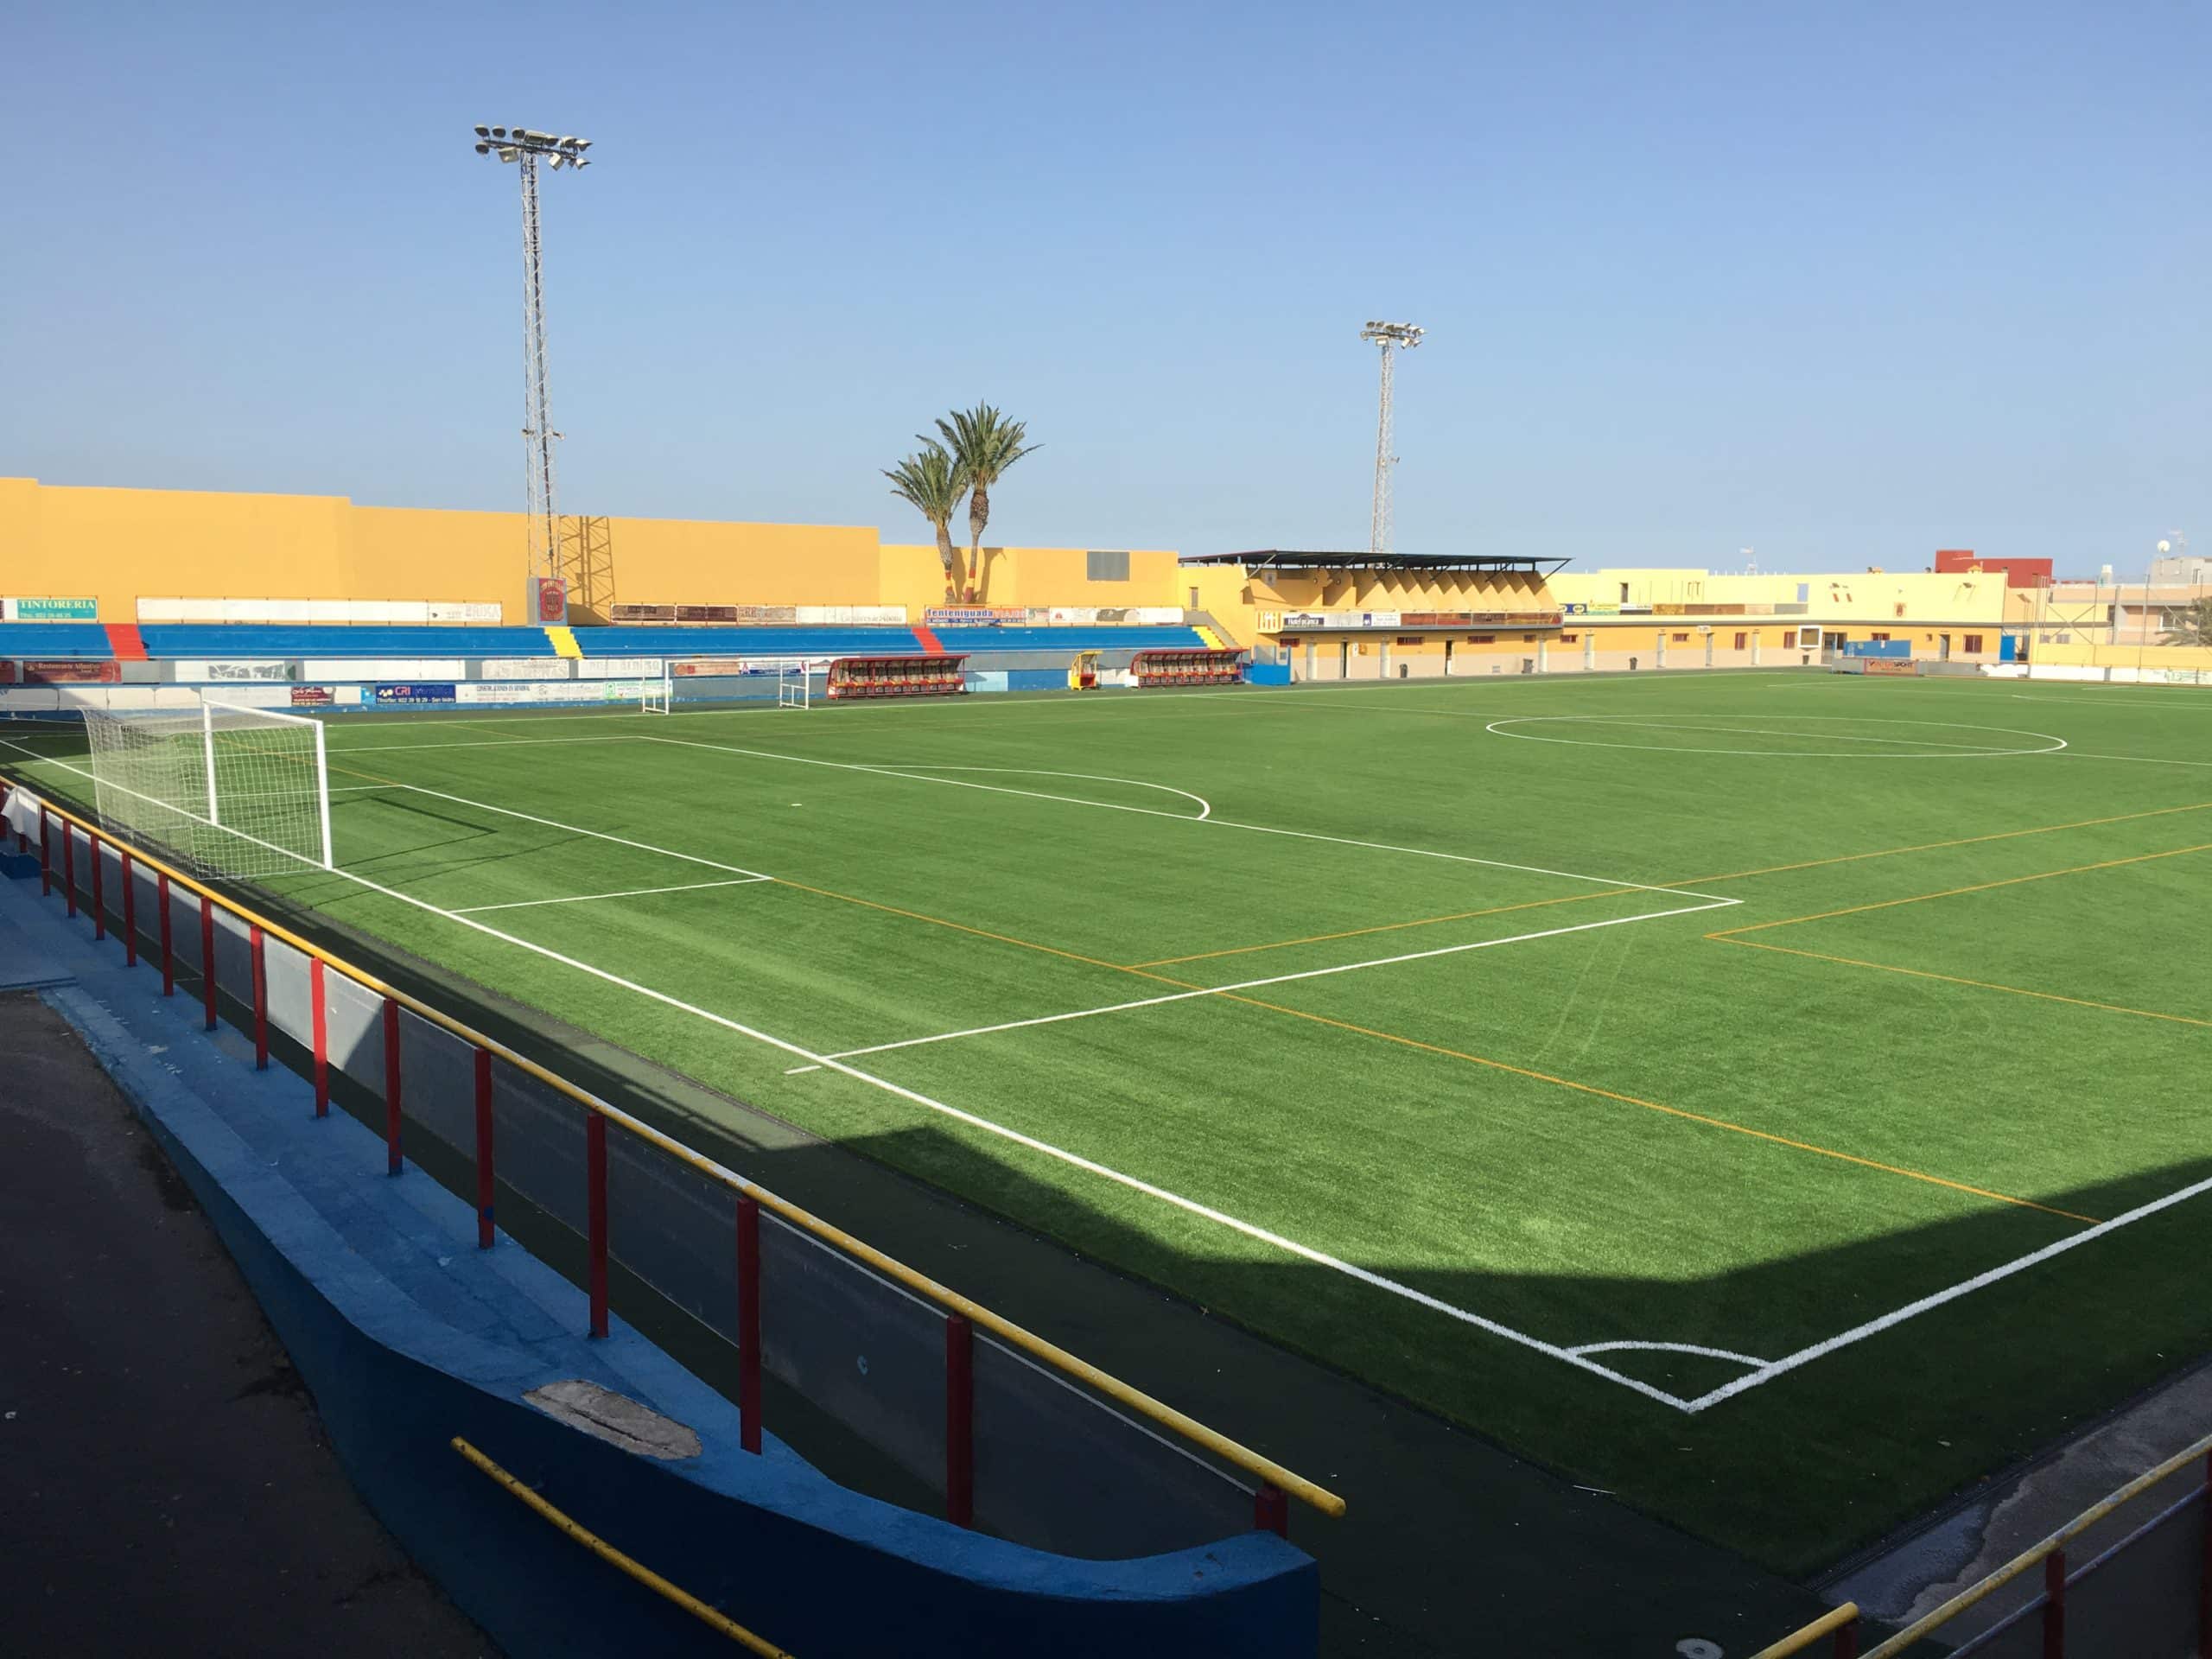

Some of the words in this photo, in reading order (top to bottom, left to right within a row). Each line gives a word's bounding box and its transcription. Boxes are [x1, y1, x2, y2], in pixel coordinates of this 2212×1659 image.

[20, 600, 95, 609] TINTORERIA
[926, 608, 994, 618] Tenteniguada
[394, 686, 411, 696] CRI
